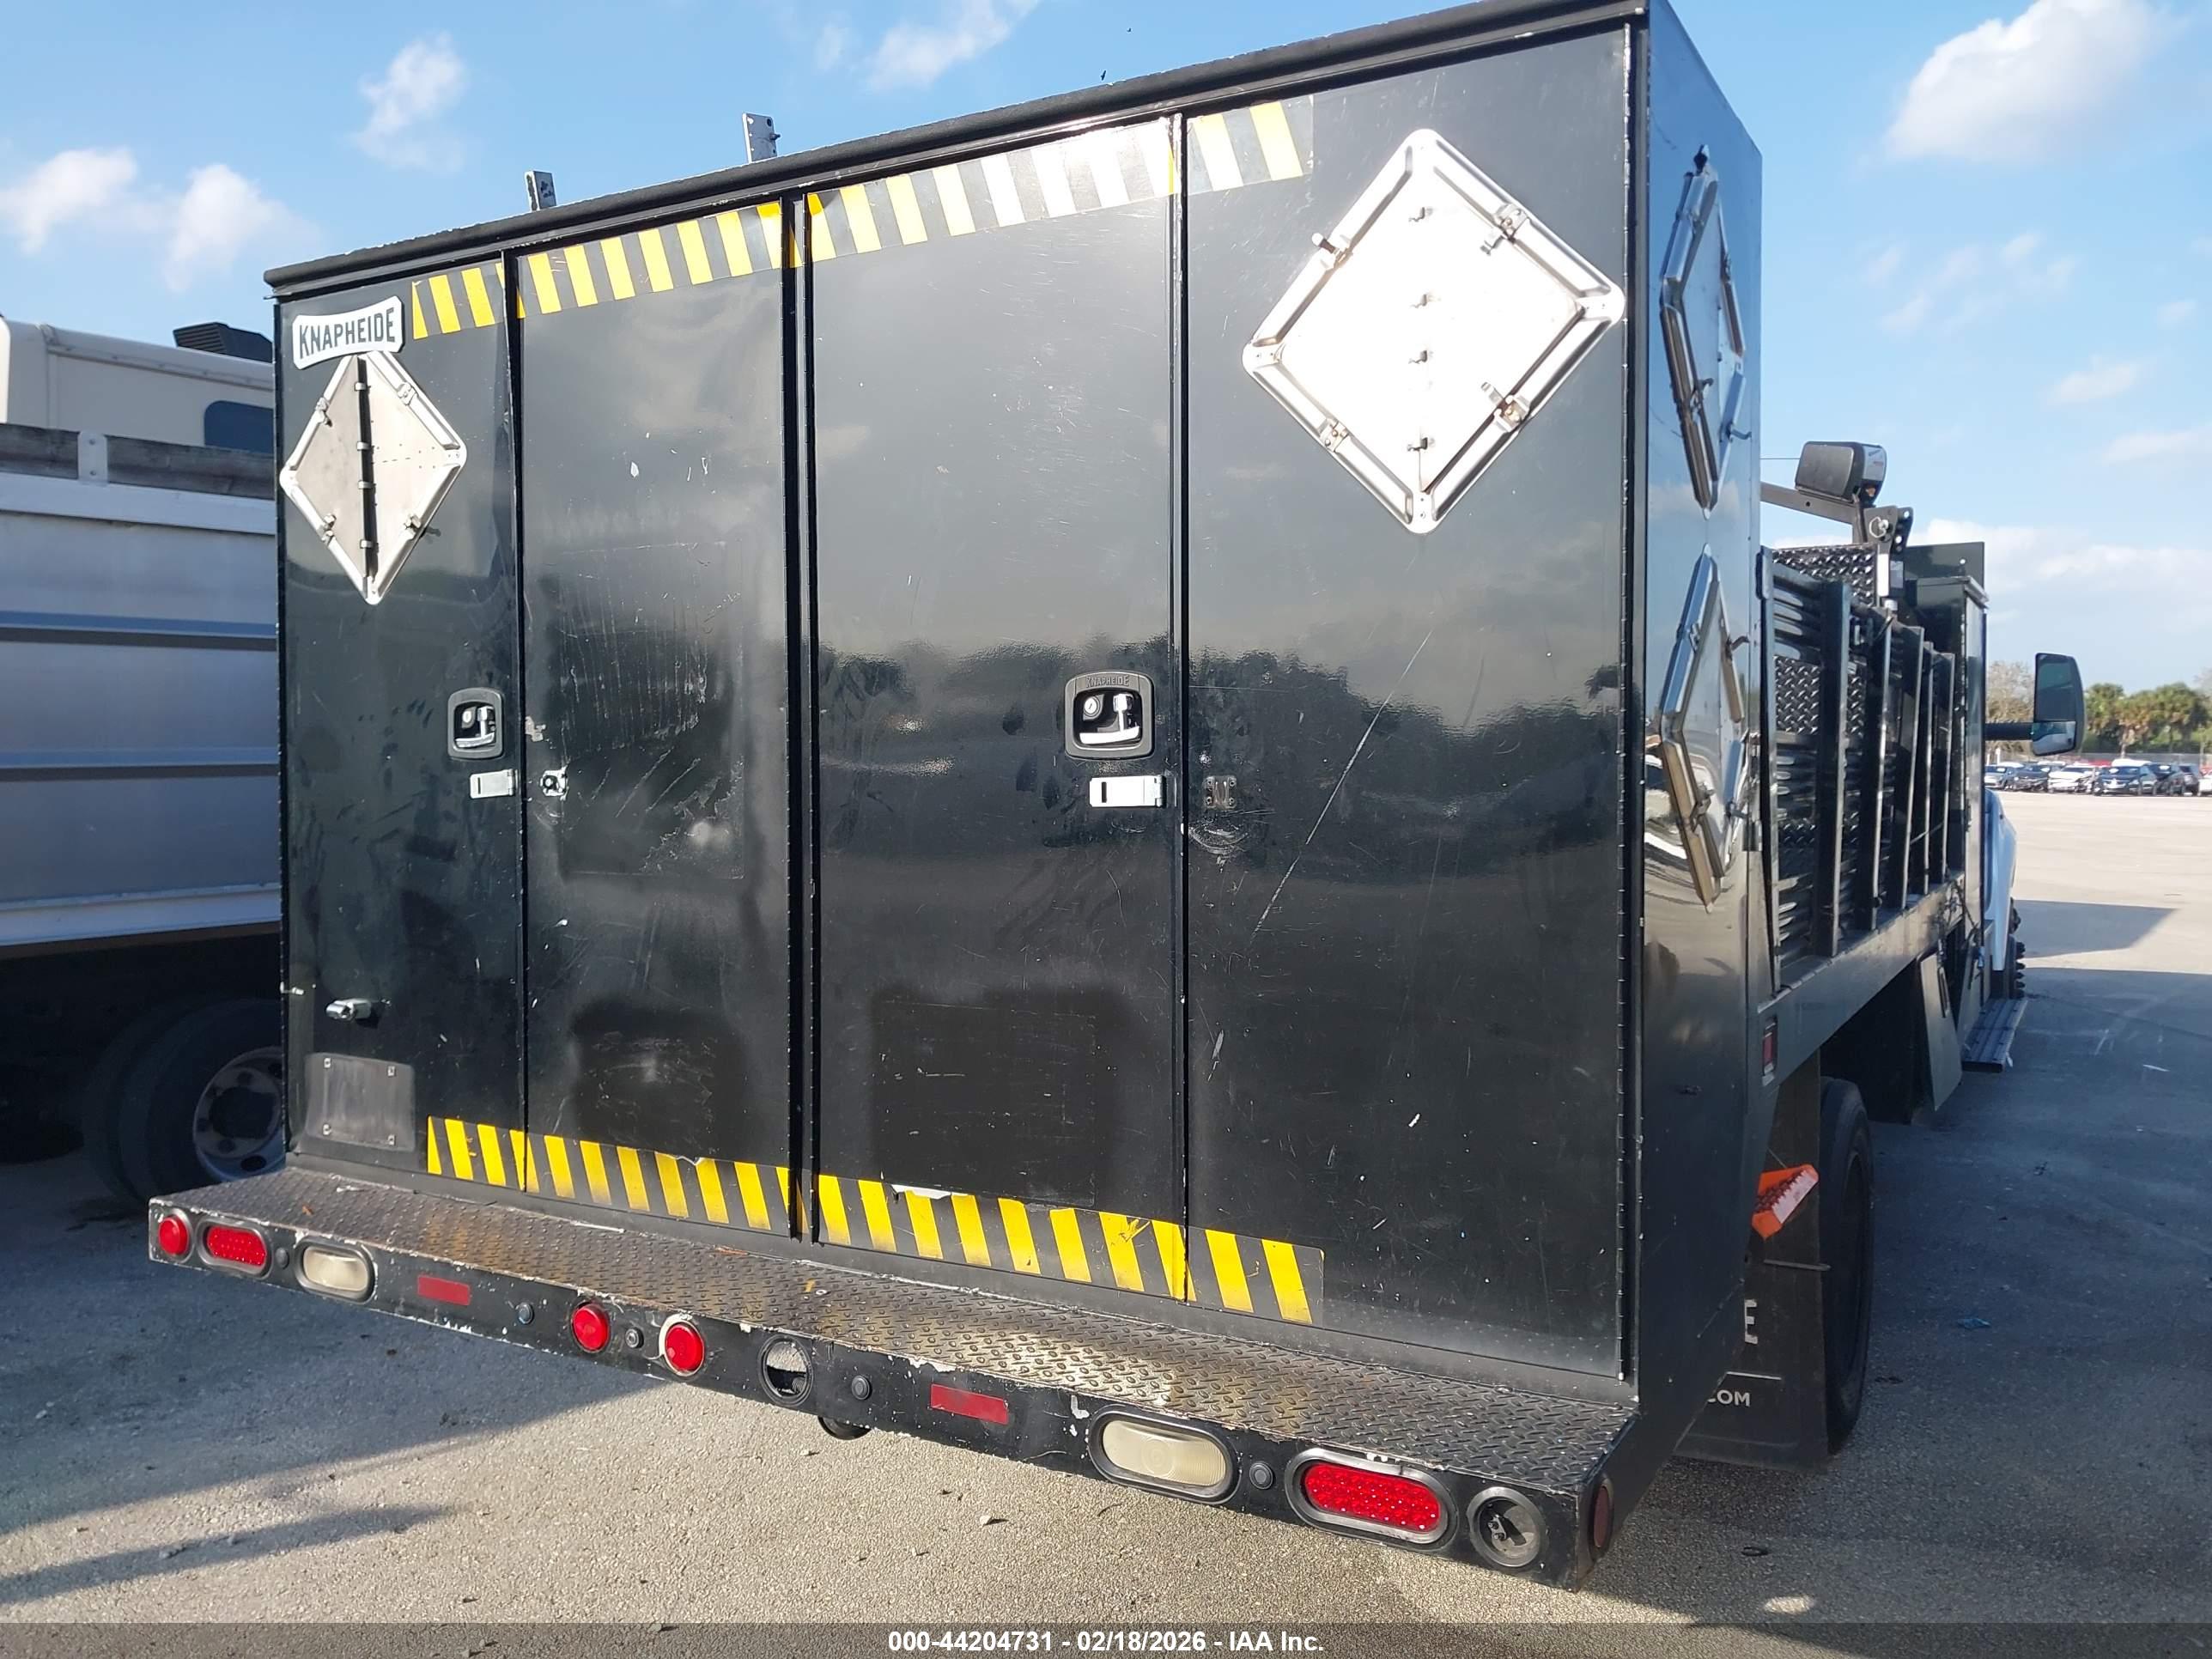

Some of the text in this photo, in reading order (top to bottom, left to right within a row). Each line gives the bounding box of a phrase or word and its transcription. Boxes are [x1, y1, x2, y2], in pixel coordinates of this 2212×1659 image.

[299, 307, 396, 359] KNAPHEIDE
[1085, 674, 1130, 688] KNAPHEIDE
[1707, 1389, 1751, 1407] OM
